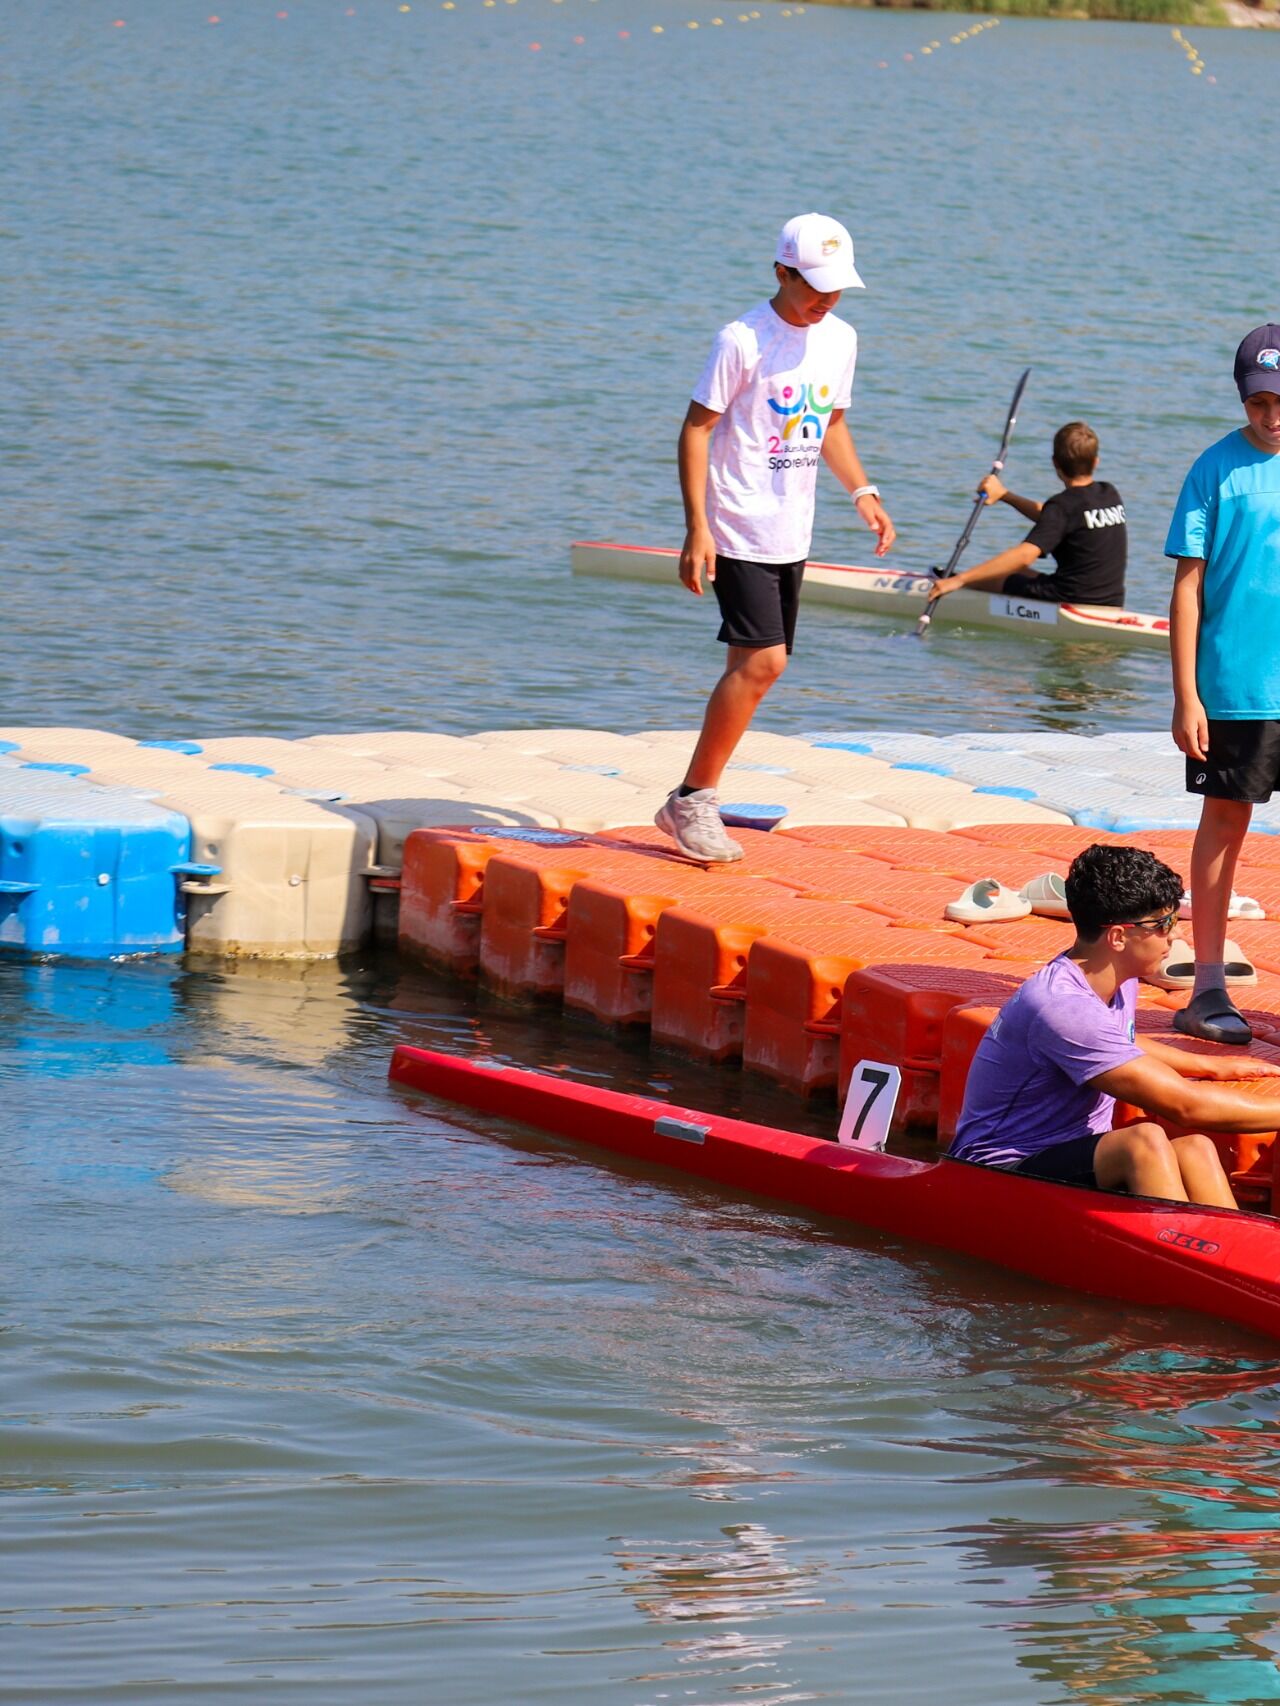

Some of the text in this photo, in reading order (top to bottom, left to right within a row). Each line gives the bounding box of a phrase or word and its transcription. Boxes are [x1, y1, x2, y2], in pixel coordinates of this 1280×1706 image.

[1017, 605, 1040, 619] Can
[851, 1068, 890, 1140] 7
[1159, 1230, 1218, 1253] NELO
